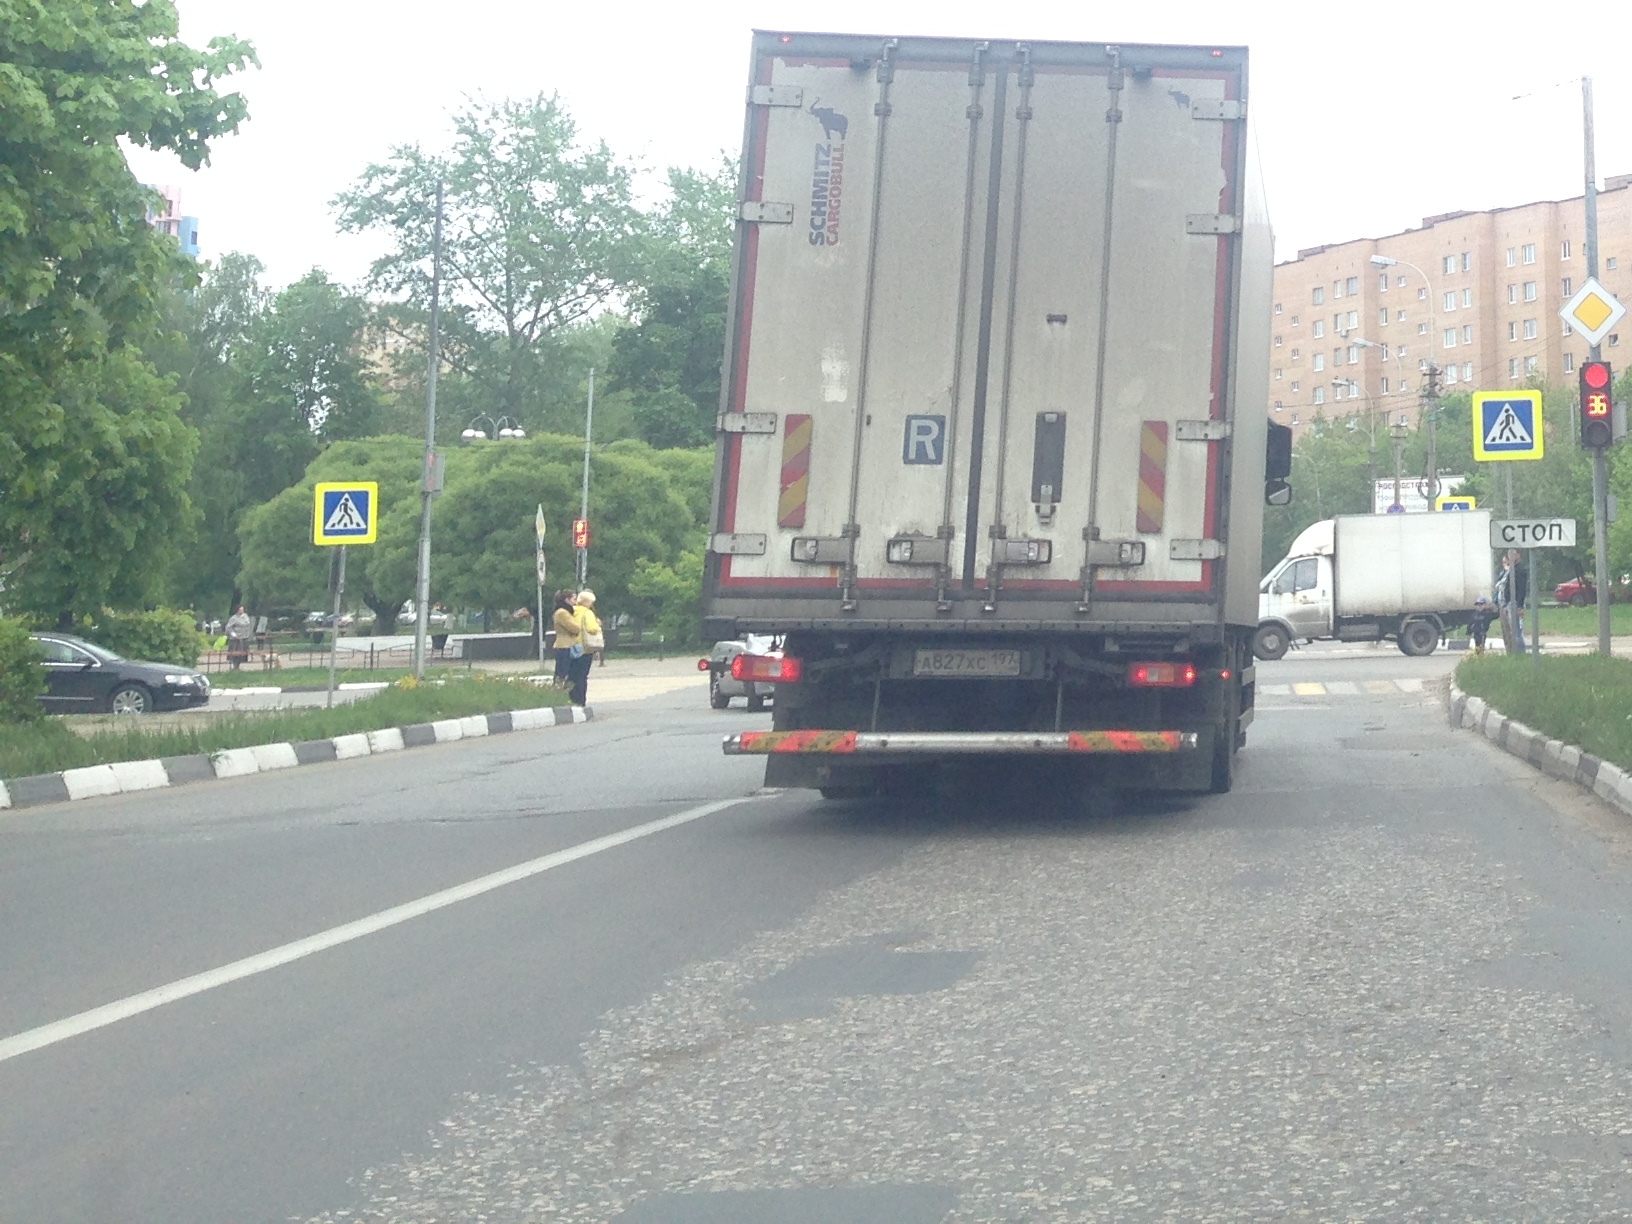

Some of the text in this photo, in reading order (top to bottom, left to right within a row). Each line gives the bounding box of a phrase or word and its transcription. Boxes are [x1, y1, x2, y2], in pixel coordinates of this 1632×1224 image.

[809, 143, 831, 246] SCHMITZ
[826, 143, 845, 246] CARGOBULL
[908, 419, 940, 460] R
[1502, 523, 1562, 542] СТОП
